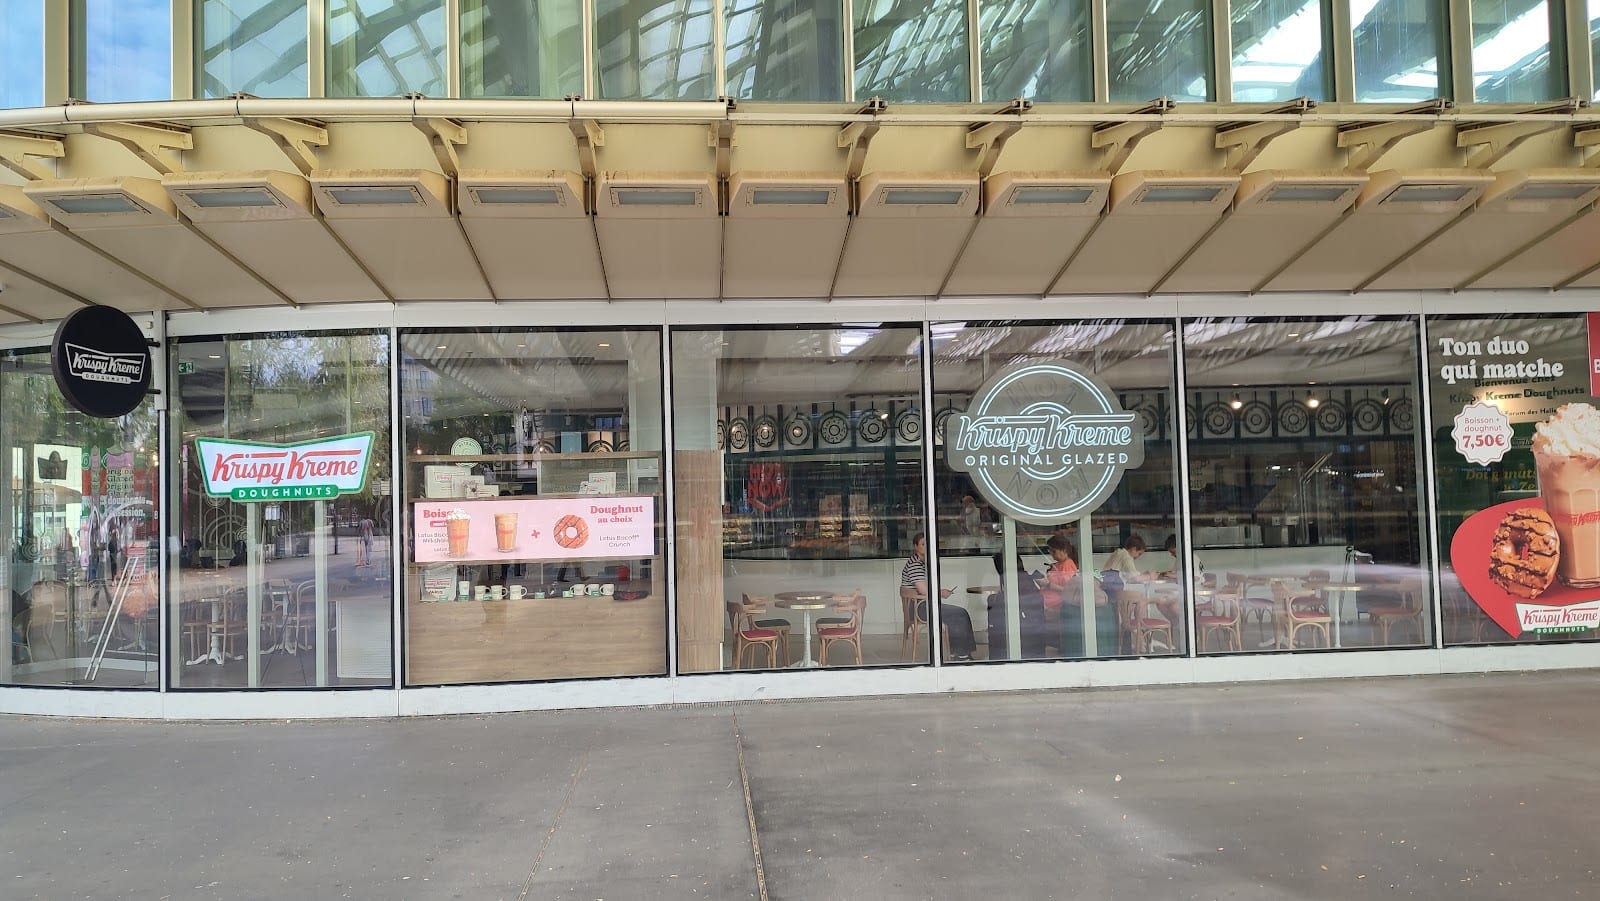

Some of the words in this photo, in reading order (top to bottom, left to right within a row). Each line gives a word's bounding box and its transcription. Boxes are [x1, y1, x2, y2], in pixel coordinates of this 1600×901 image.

[1439, 338, 1482, 356] Ton
[1487, 336, 1530, 355] duo
[72, 352, 110, 374] Krispy
[108, 357, 142, 375] Kreme
[1440, 359, 1478, 384] qui
[1483, 358, 1564, 378] matche
[1523, 386, 1585, 400] Doughnuts
[955, 414, 1050, 456] Krispy
[1046, 413, 1136, 451] Kreme
[1464, 424, 1502, 432] doughnut
[1462, 434, 1505, 449] 7,50€
[211, 452, 288, 485] Krispy
[287, 449, 362, 480] Kreme
[965, 454, 1053, 467] ORIGINAL
[1061, 452, 1129, 466] GLAZED
[238, 487, 332, 498] DOUGHNUTS
[590, 505, 643, 515] Doughnut
[1523, 609, 1562, 626] Krispy
[1561, 607, 1599, 622] Kreme
